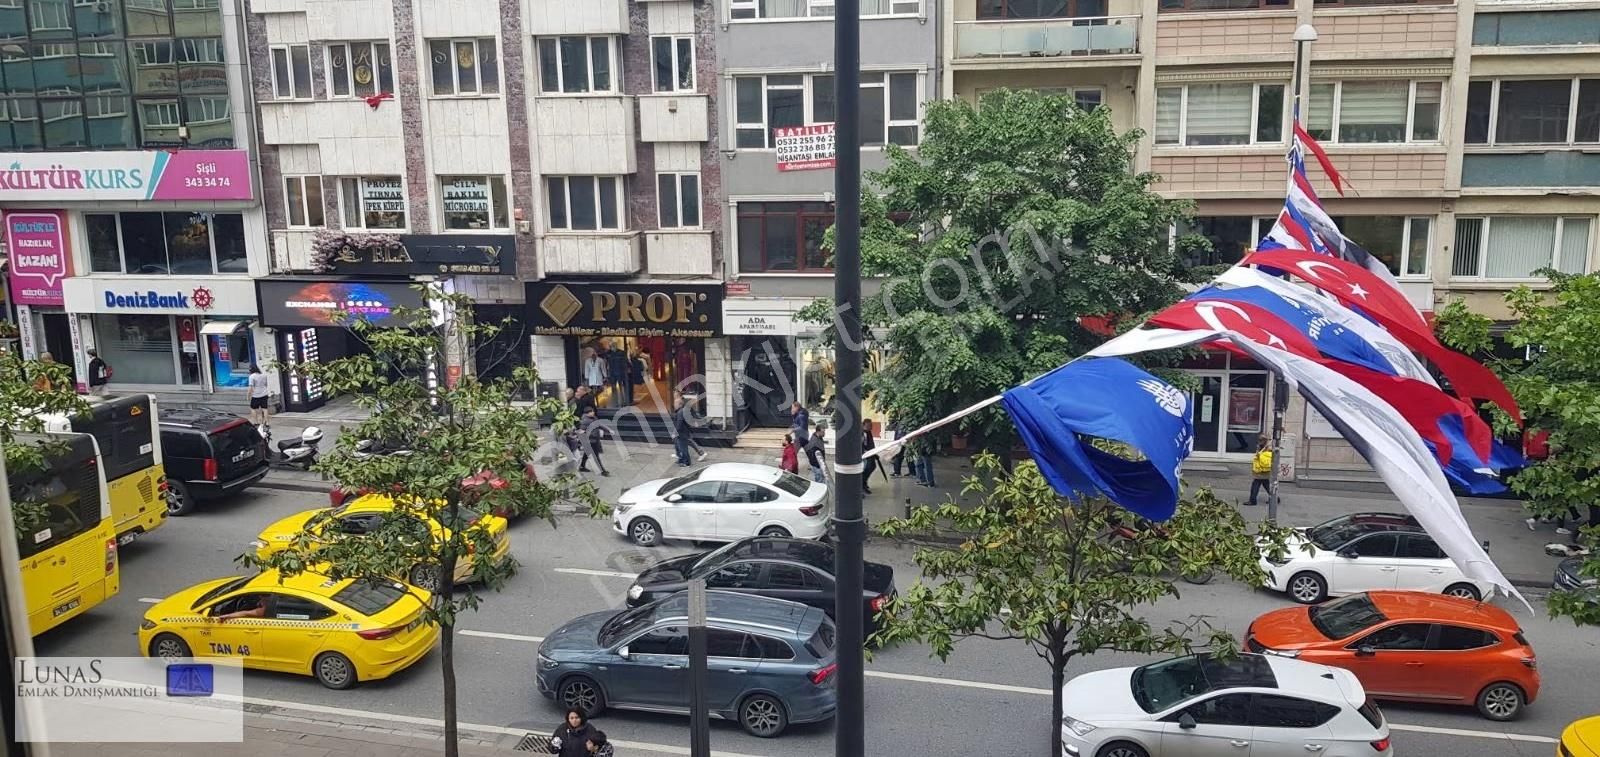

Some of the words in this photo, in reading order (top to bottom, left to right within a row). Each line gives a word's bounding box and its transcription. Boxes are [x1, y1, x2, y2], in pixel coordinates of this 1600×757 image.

[778, 125, 835, 137] SATILIK
[777, 138, 798, 146] 0532
[800, 136, 814, 144] 255
[816, 135, 826, 143] 96
[777, 146, 798, 154] 0532
[196, 163, 216, 174] Şişli
[185, 177, 203, 188] 343
[204, 177, 216, 188] 34
[218, 177, 231, 188] 74
[17, 254, 59, 268] KAZAN!
[104, 290, 189, 309] DenizBank
[285, 301, 337, 309] EXCHANGE
[209, 642, 232, 655] TAN
[237, 644, 250, 656] 48
